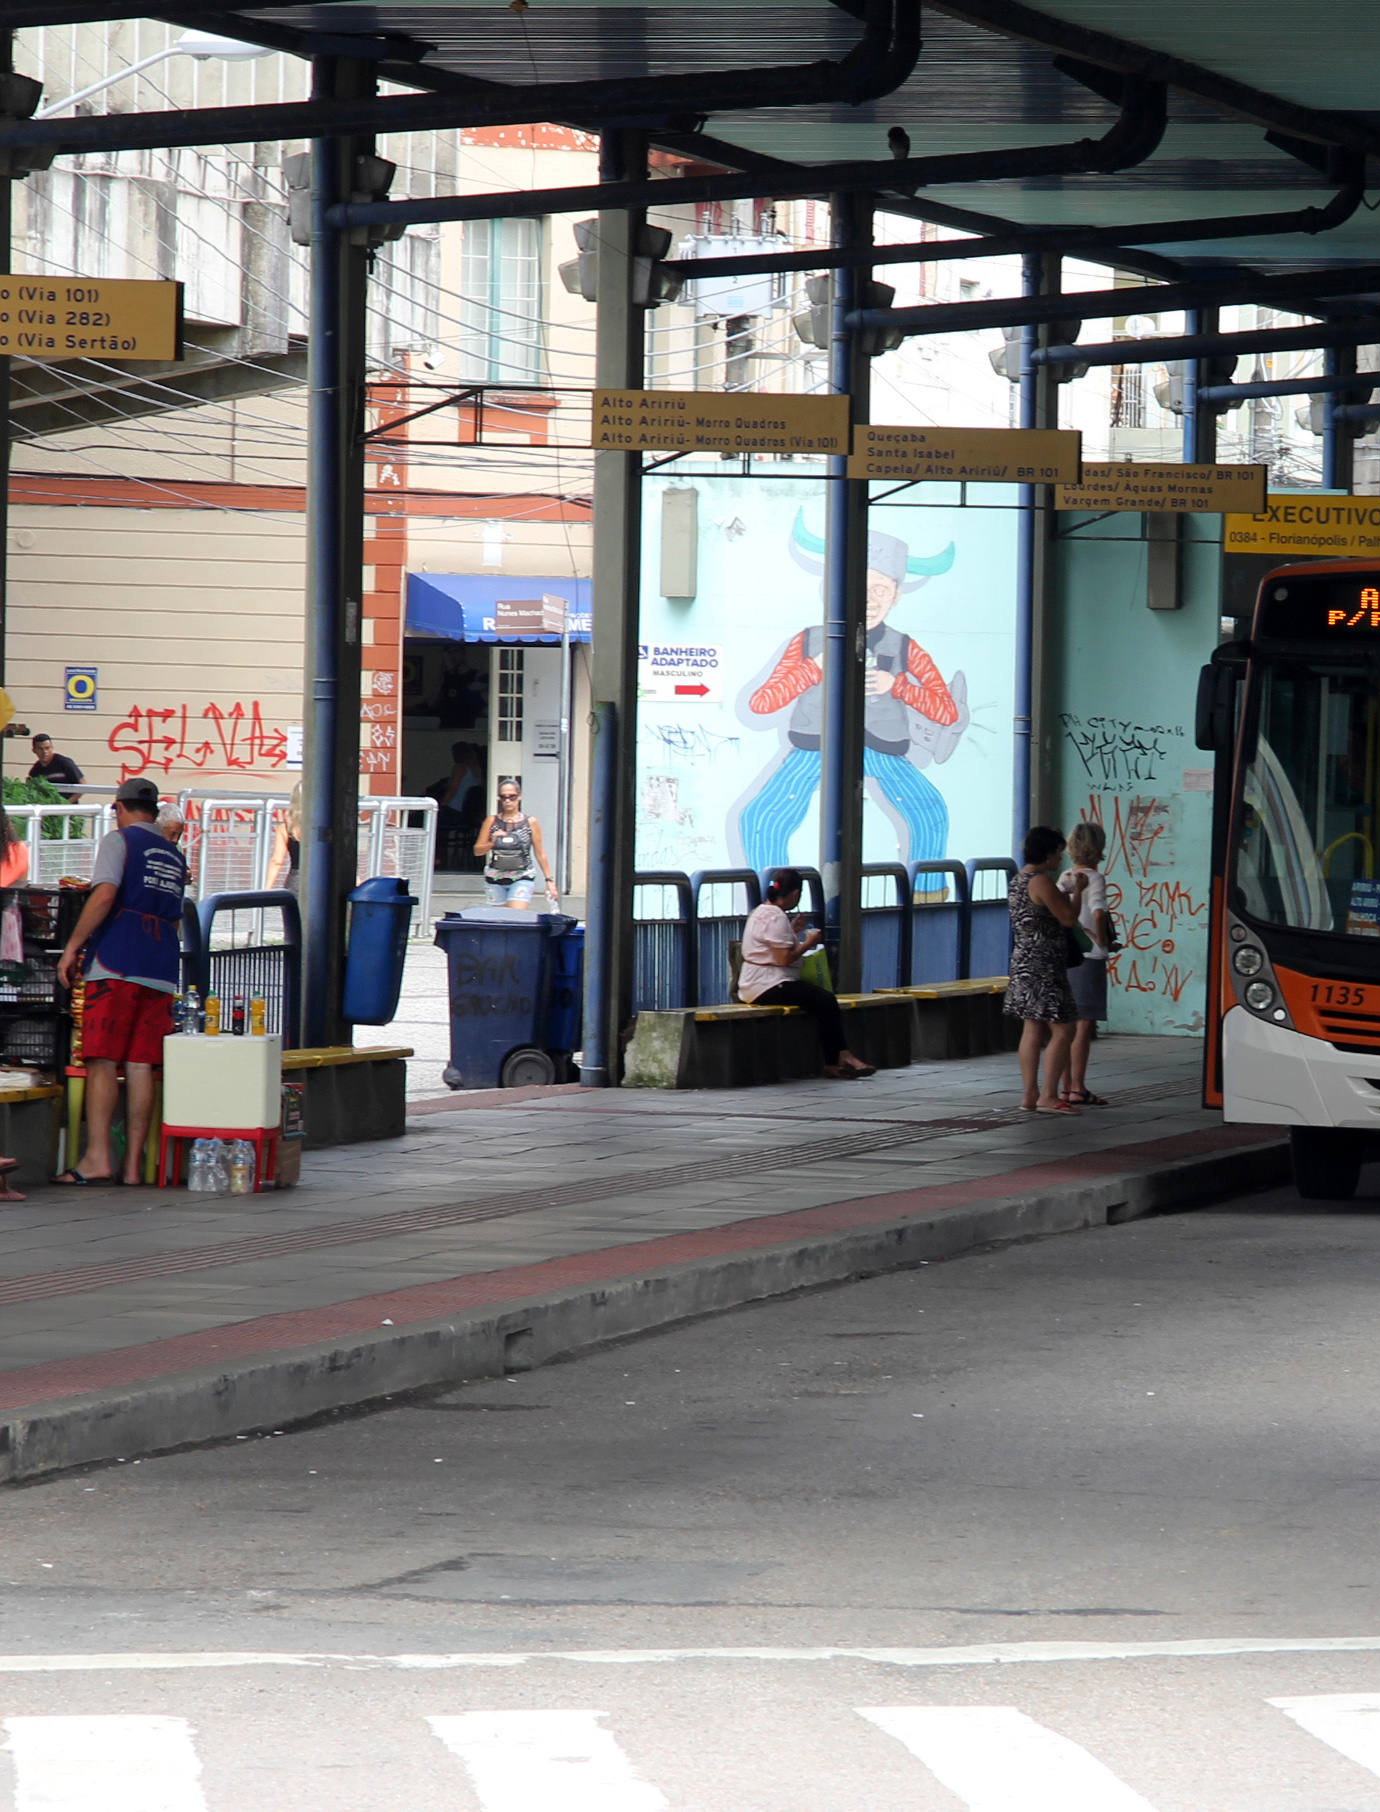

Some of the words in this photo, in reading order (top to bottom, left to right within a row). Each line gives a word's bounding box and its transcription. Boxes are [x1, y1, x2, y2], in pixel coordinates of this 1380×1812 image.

[19, 287, 57, 302] (Via
[66, 288, 99, 303] 101)
[18, 310, 56, 325] (Via
[65, 311, 111, 327] 282)
[17, 333, 56, 348] (Via
[65, 335, 137, 351] Sertão)
[601, 397, 633, 408] Alto
[638, 397, 686, 410] Aririú
[600, 415, 633, 426] Alto
[696, 417, 731, 429] Morro
[735, 418, 786, 430] Quadros
[600, 433, 632, 444] Alto
[696, 435, 730, 446] Morro
[735, 436, 786, 448] Quadros
[790, 436, 813, 448] (Via
[817, 437, 838, 449] 101)
[867, 431, 926, 444] Queçaba
[867, 447, 908, 458] Santa
[913, 449, 955, 459] Isabel
[866, 463, 920, 475] Capela/
[925, 465, 954, 476] Alto
[1017, 467, 1035, 477] BR
[1040, 468, 1059, 478] 101
[1116, 468, 1139, 480] São
[1144, 469, 1212, 480] Francisco/
[1217, 470, 1232, 480] BR
[1237, 471, 1254, 480] 101
[1123, 480, 1163, 494] Águas
[1167, 484, 1213, 494] Mornas
[1063, 496, 1110, 508] Vargem
[1116, 497, 1165, 508] Grande/
[1171, 498, 1187, 508] BR
[1191, 499, 1208, 508] 101
[1229, 531, 1258, 543] 0384
[1269, 532, 1348, 548] Florianópolis
[653, 646, 717, 657] BANHEIRO
[651, 657, 719, 668] ADAPTADO
[652, 670, 703, 678] MASCULINO
[1310, 983, 1366, 1007] 1135
